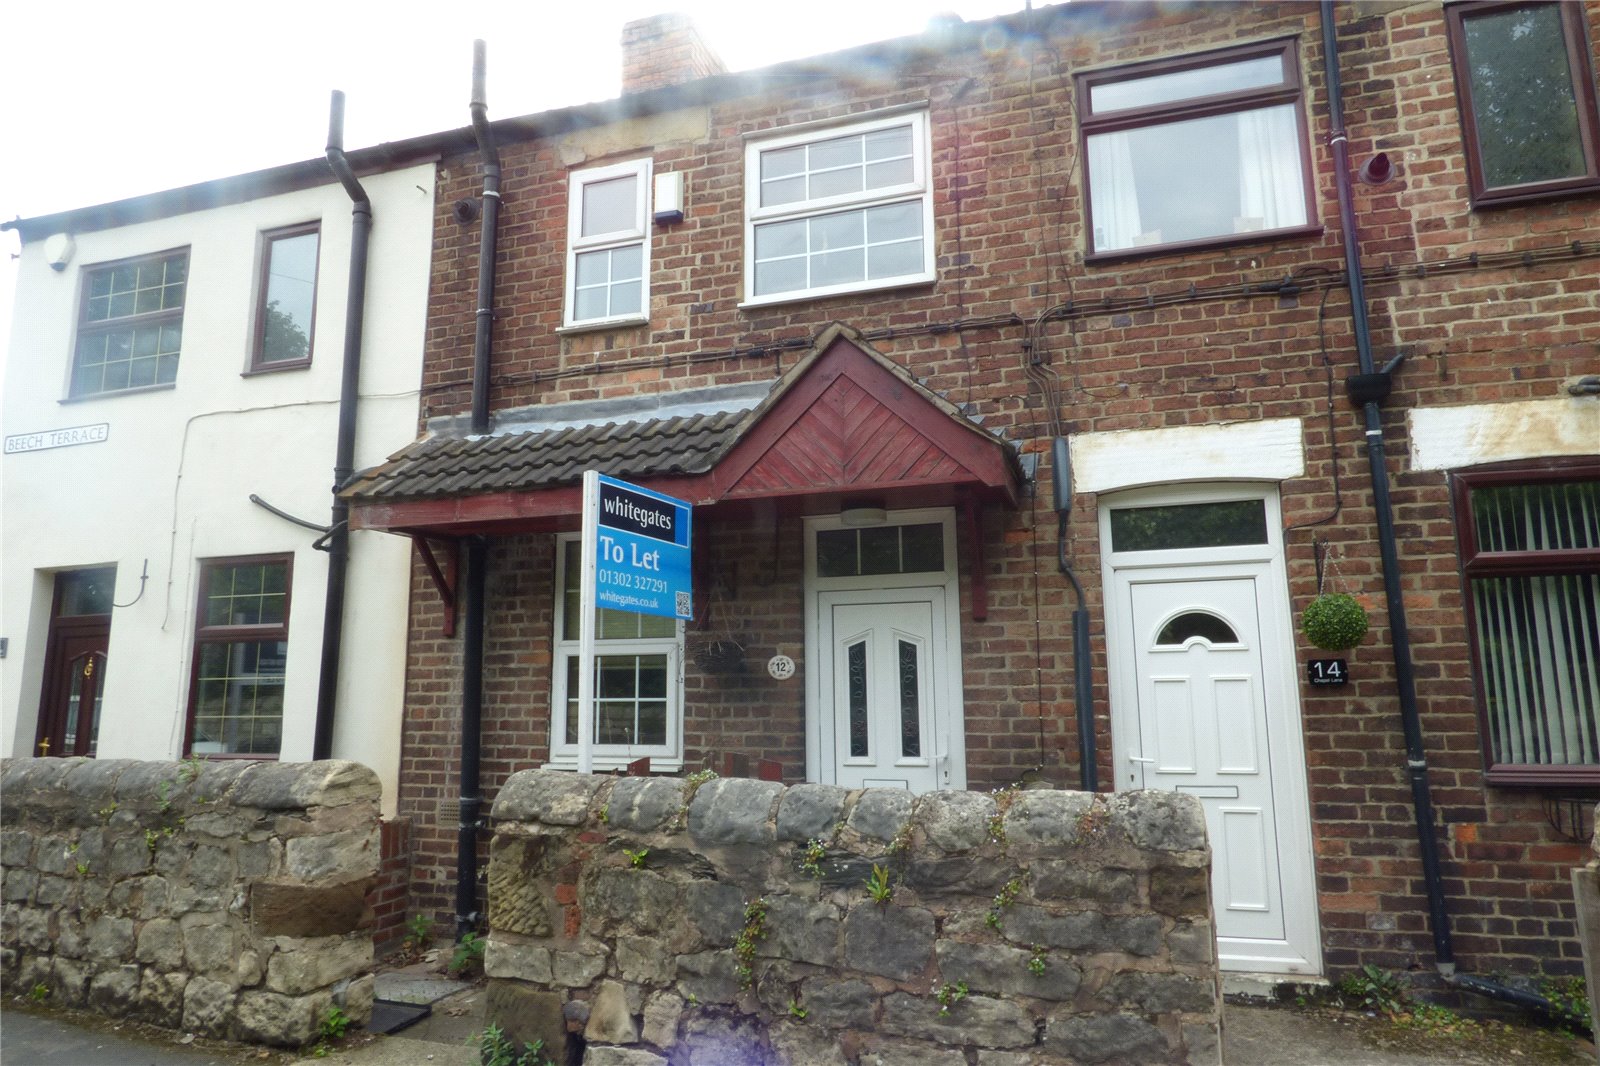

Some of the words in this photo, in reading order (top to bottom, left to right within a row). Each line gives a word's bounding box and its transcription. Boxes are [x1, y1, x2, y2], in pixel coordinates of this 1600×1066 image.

[8, 435, 43, 451] BEECH
[50, 427, 104, 446] TERRACE
[604, 496, 672, 530] whitegates
[600, 535, 624, 563] To
[630, 542, 660, 571] Let
[599, 568, 632, 588] 01302
[634, 576, 668, 594] 327291
[599, 590, 659, 609] whitegates.co.uk
[775, 662, 787, 672] 12
[1313, 661, 1341, 678] 14
